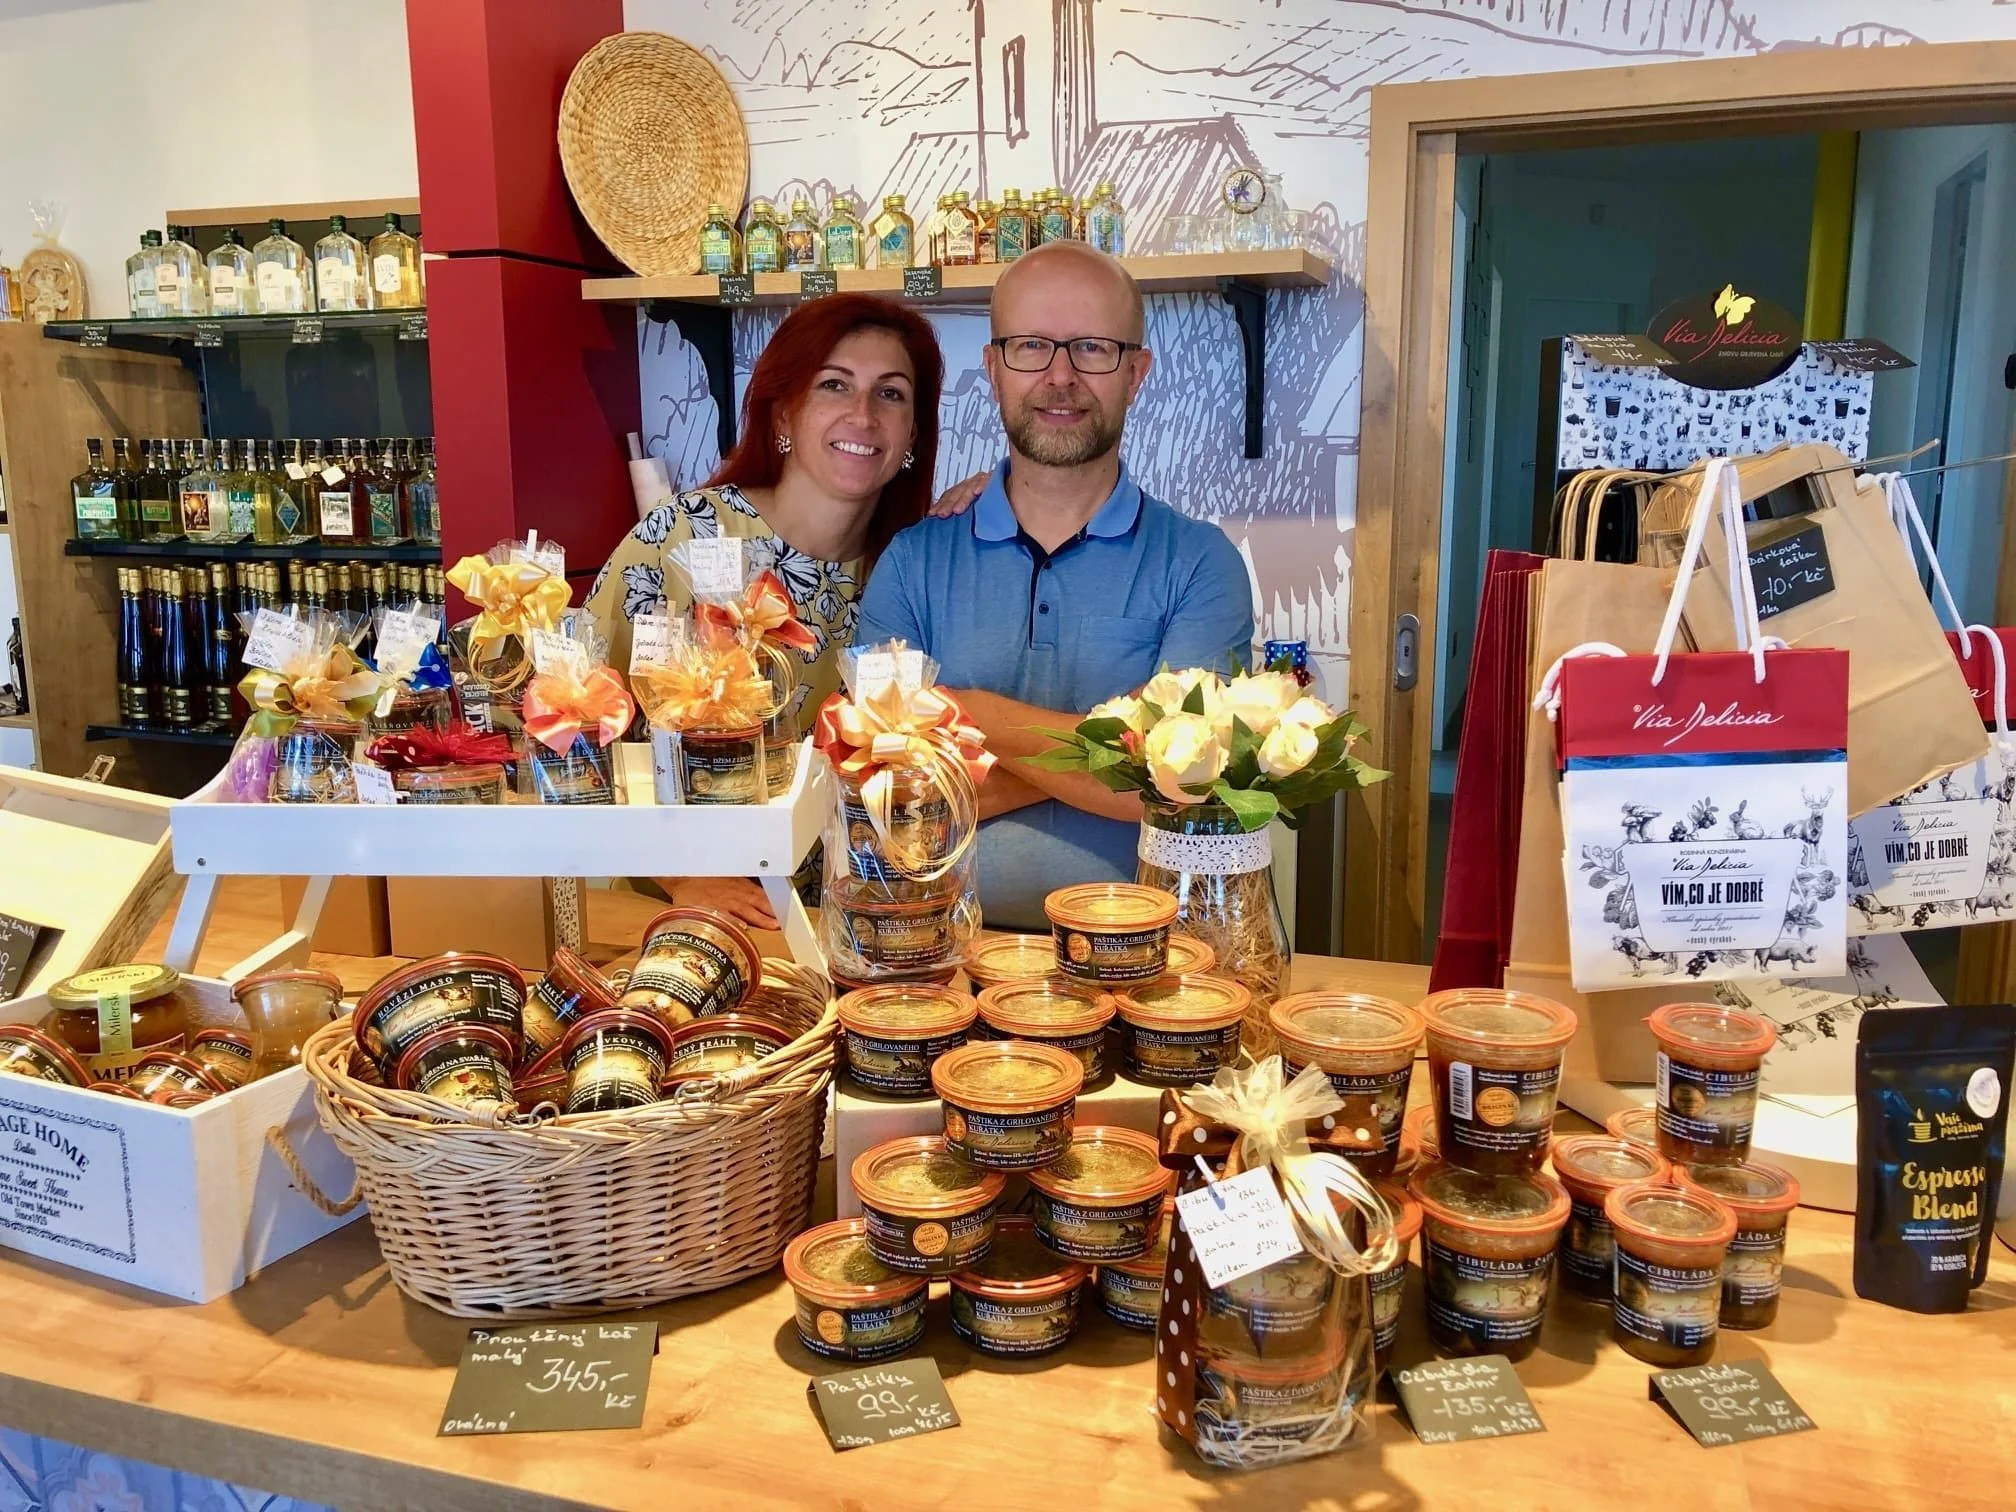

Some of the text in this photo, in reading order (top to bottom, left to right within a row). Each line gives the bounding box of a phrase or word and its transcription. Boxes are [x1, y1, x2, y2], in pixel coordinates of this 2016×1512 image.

[1663, 318, 1792, 364] Via Delicia
[1633, 701, 1785, 748] Via Delicia
[1924, 840, 1935, 860] JE
[1938, 834, 1969, 859] DOBRÉ
[1673, 856, 1754, 881] Via Delicia
[1708, 882, 1722, 904] JE
[1726, 878, 1764, 904] DOBRÉ
[419, 976, 454, 993] MASO
[968, 1114, 999, 1126] PAŠTIKA
[35, 1121, 90, 1173] HOME
[1902, 1161, 1986, 1195] Espresso
[1912, 1191, 1978, 1221] Blend
[1457, 1254, 1524, 1270] CIBULÁDA
[1647, 1265, 1714, 1280] CIBULÁDA
[851, 1310, 884, 1321] PAŠTIKA
[474, 1326, 638, 1347] Proutěný koš
[472, 1347, 527, 1365] malý
[822, 1371, 914, 1395] Paštiky
